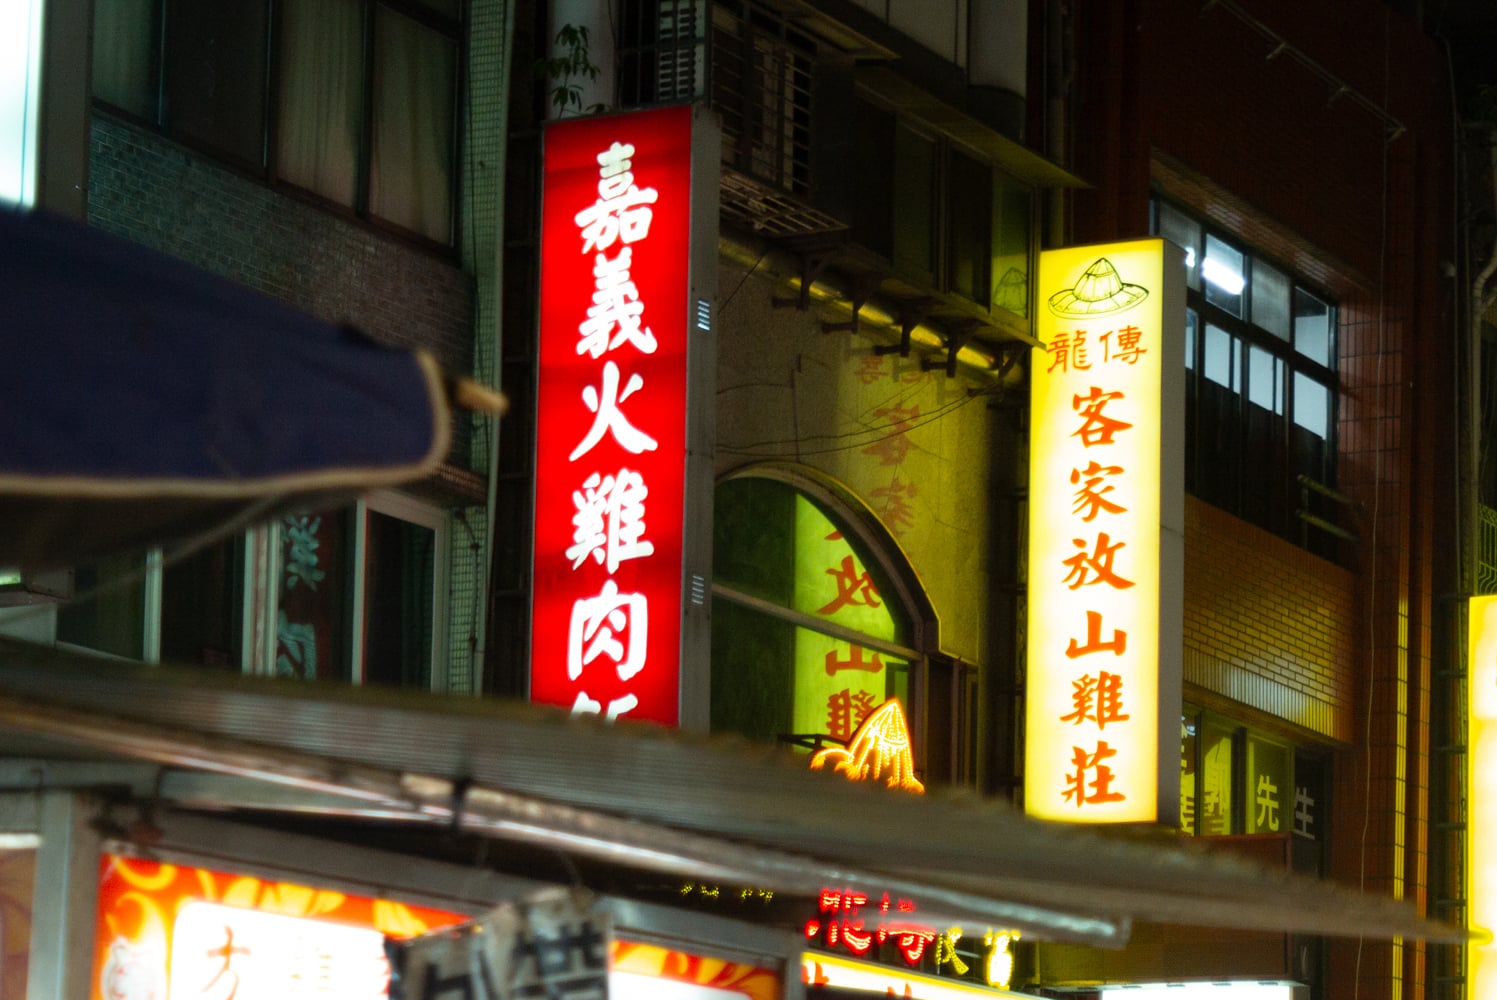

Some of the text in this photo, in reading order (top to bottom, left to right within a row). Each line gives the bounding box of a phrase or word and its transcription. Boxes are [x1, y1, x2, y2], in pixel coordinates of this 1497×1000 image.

[1060, 386, 1137, 809] 客家放山雞莊
